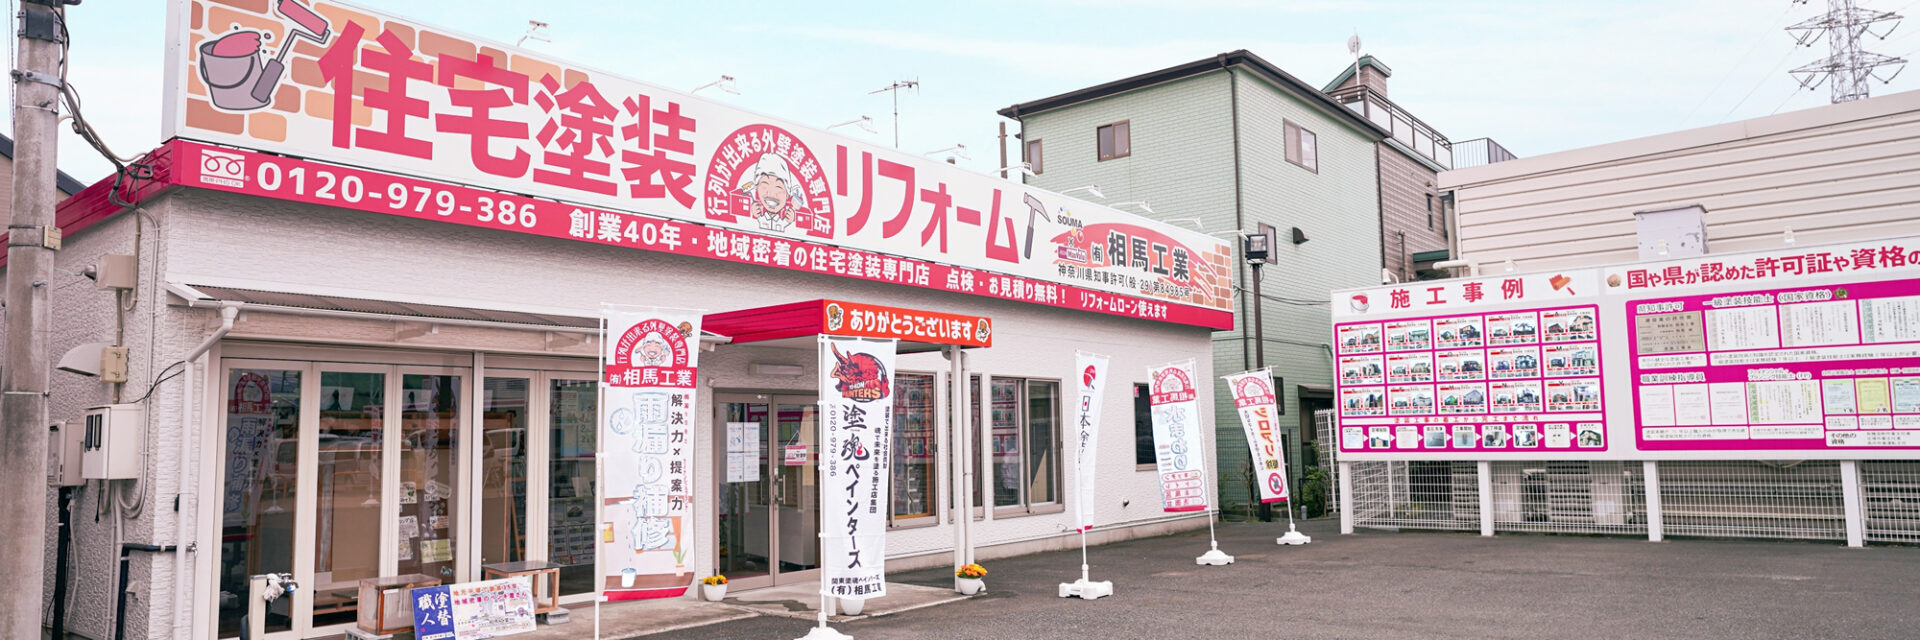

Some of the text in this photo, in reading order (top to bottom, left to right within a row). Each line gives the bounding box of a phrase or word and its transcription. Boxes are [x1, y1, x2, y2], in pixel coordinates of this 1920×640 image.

[317, 20, 697, 210] 住宅塗装
[257, 162, 538, 228] 0120-979-386
[708, 128, 832, 235] 行列が出来る外壁塗装専門店
[836, 143, 1020, 264] リフォーム
[1057, 214, 1084, 229] SOUMA
[568, 208, 930, 286] 創業40年・地域密着の住宅塗装専門店
[1080, 291, 1168, 320] リフォームローン使えます
[1390, 277, 1524, 309] 施工事例
[850, 309, 972, 341] ありがとうございます
[631, 391, 670, 550] 雨漏り補修
[671, 393, 684, 512] 解決力×提案力
[829, 411, 837, 478] 0120-979-386
[840, 403, 871, 570] 塗魂ペインターズ
